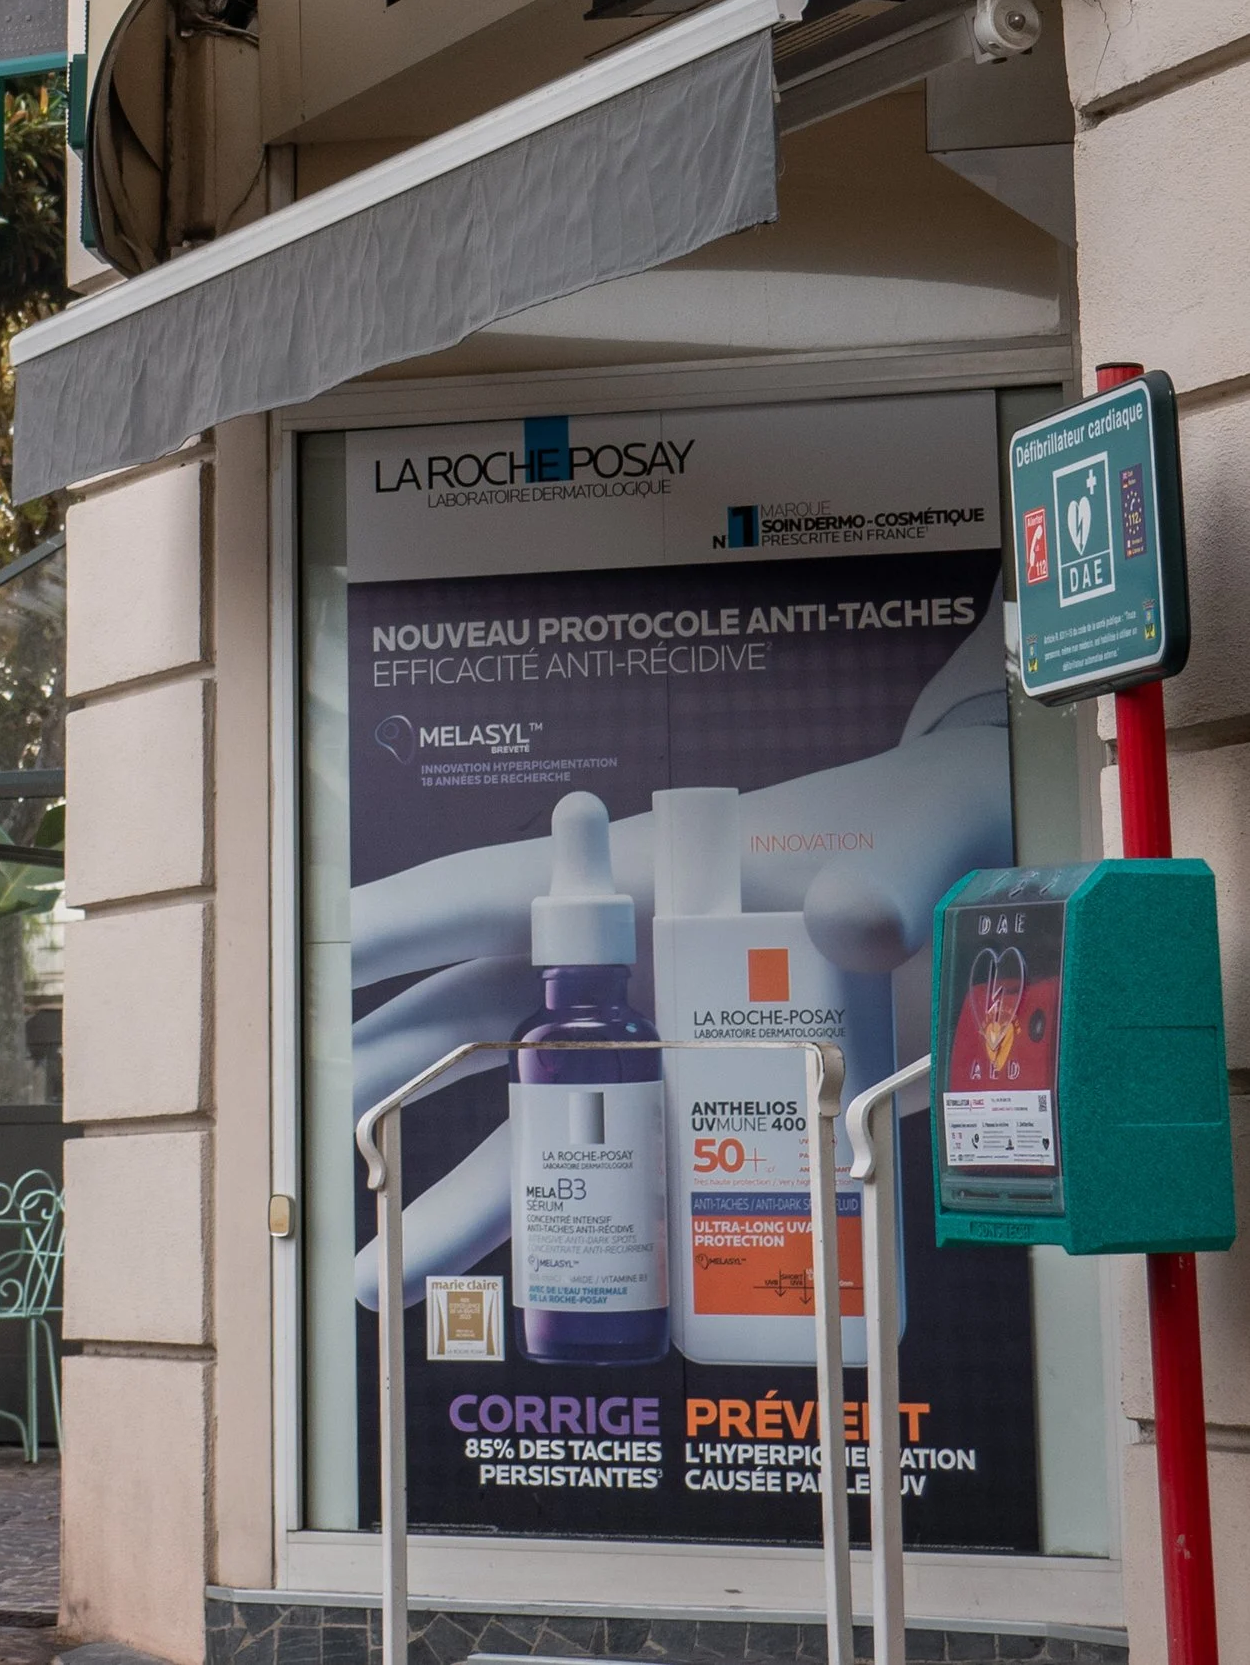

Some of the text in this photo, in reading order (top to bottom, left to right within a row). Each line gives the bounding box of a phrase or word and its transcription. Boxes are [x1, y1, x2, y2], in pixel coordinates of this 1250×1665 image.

[1015, 402, 1143, 467] Défibrillateur cardiaque
[375, 439, 695, 493] LA ROCHE POSAY
[428, 479, 671, 508] LABORATOIRE DERMATOLOGIQUE
[761, 500, 831, 517] MARQUE
[761, 517, 803, 534] SOIN
[762, 531, 841, 547] PRESCRITE
[843, 530, 863, 543] EN
[1070, 559, 1103, 592] DAE
[373, 597, 975, 652] NOUVEAU PROTOCOLE ANTI-TACHES
[374, 647, 539, 687] EFFICACITÉ
[490, 744, 530, 754] BREVETÉ
[421, 757, 617, 774] INNOVATION HYPERPIGMENTATION
[421, 772, 571, 787] 18 ANNÉES DE RECHERCHE
[750, 833, 874, 852] INNOVATION
[694, 1009, 846, 1026] LA ROCHE-POSAY
[694, 1027, 846, 1039] LABORATOIRE DERMATOLOGIQUE
[691, 1101, 797, 1116] ANTHELIOS
[692, 1117, 806, 1132] UVMUNE 400
[542, 1150, 633, 1161] LA ROCHE-POSAY
[693, 1138, 767, 1173] 50+
[526, 1198, 563, 1211] SÉRUM
[527, 1213, 612, 1224] CONCENTRÉ INTENSIF
[694, 1221, 813, 1233] ULTRA-LONG UVA
[694, 1235, 785, 1247] PROTECTION
[432, 1280, 498, 1290] marie claire
[582, 1286, 628, 1295] THERMALE
[549, 1295, 608, 1304] ROCHE-POSAY
[449, 1394, 661, 1436] CORRIGE
[465, 1438, 663, 1462] 85% DES TACHES
[684, 1467, 781, 1492] CAUSÉE
[786, 1472, 823, 1493] PA
